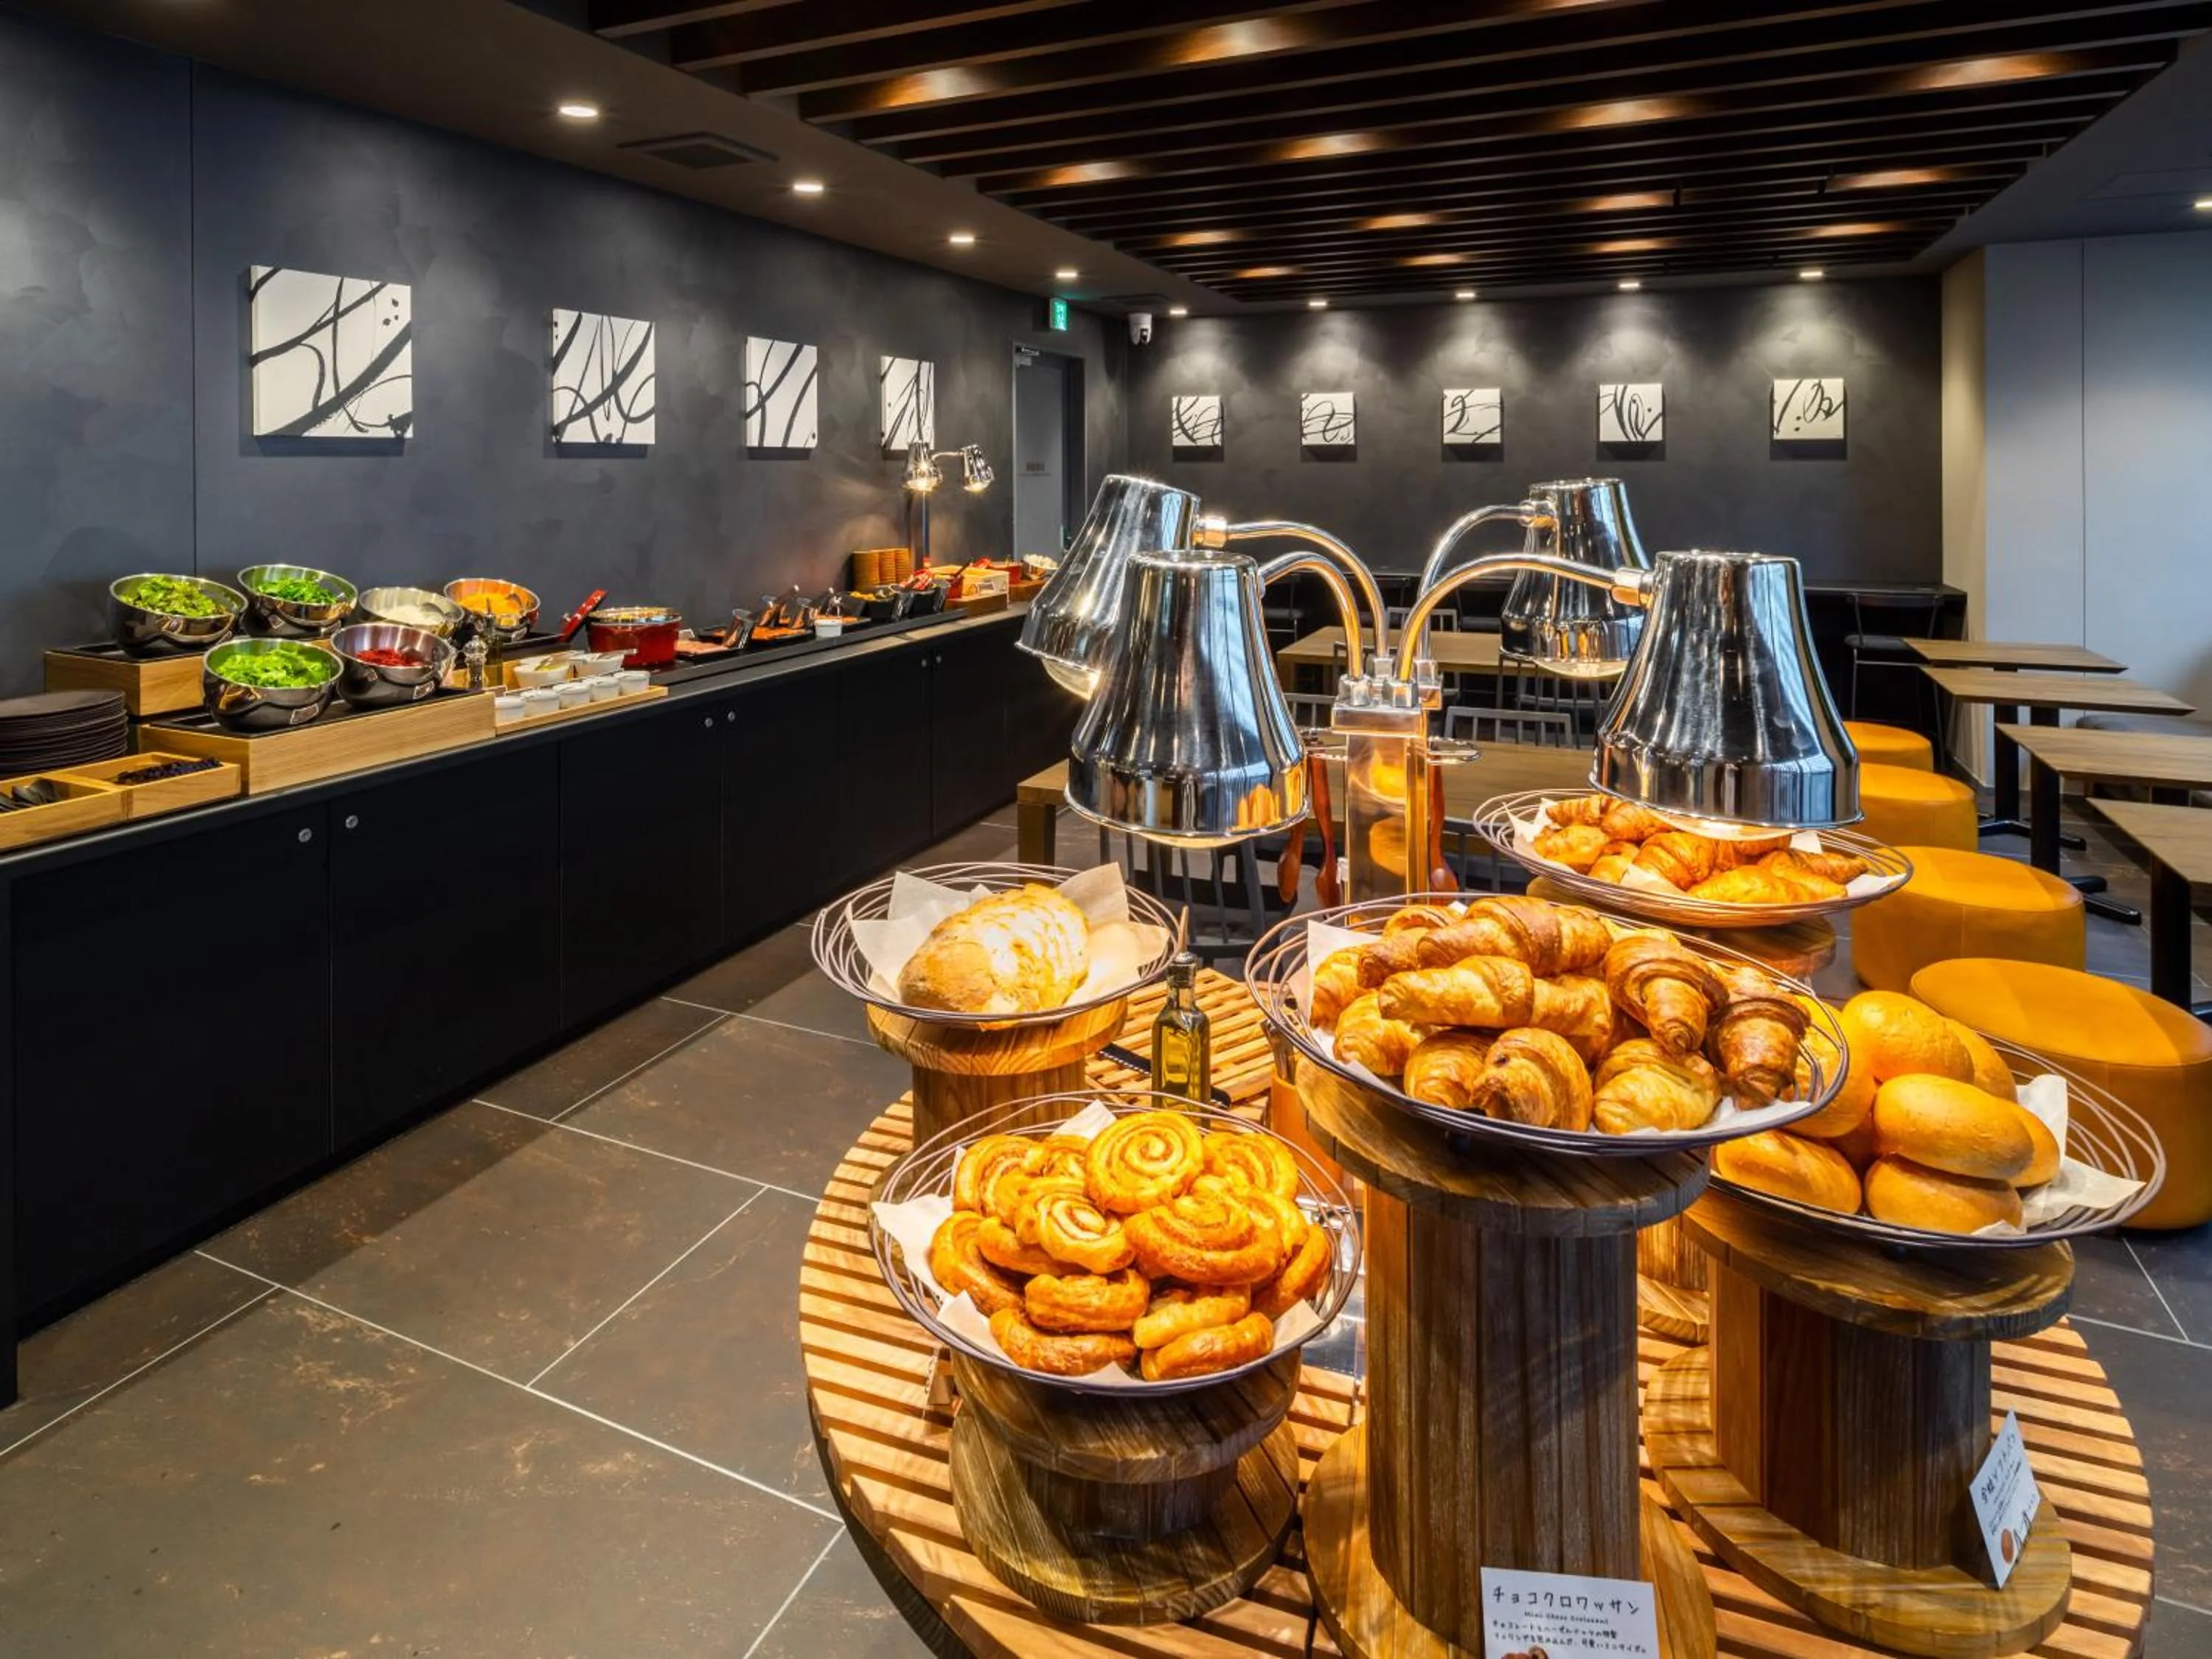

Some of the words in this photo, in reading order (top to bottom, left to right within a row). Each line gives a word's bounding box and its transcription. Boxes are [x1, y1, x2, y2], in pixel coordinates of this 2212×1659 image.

[1493, 1586, 1639, 1615] チョコクロワッサン
